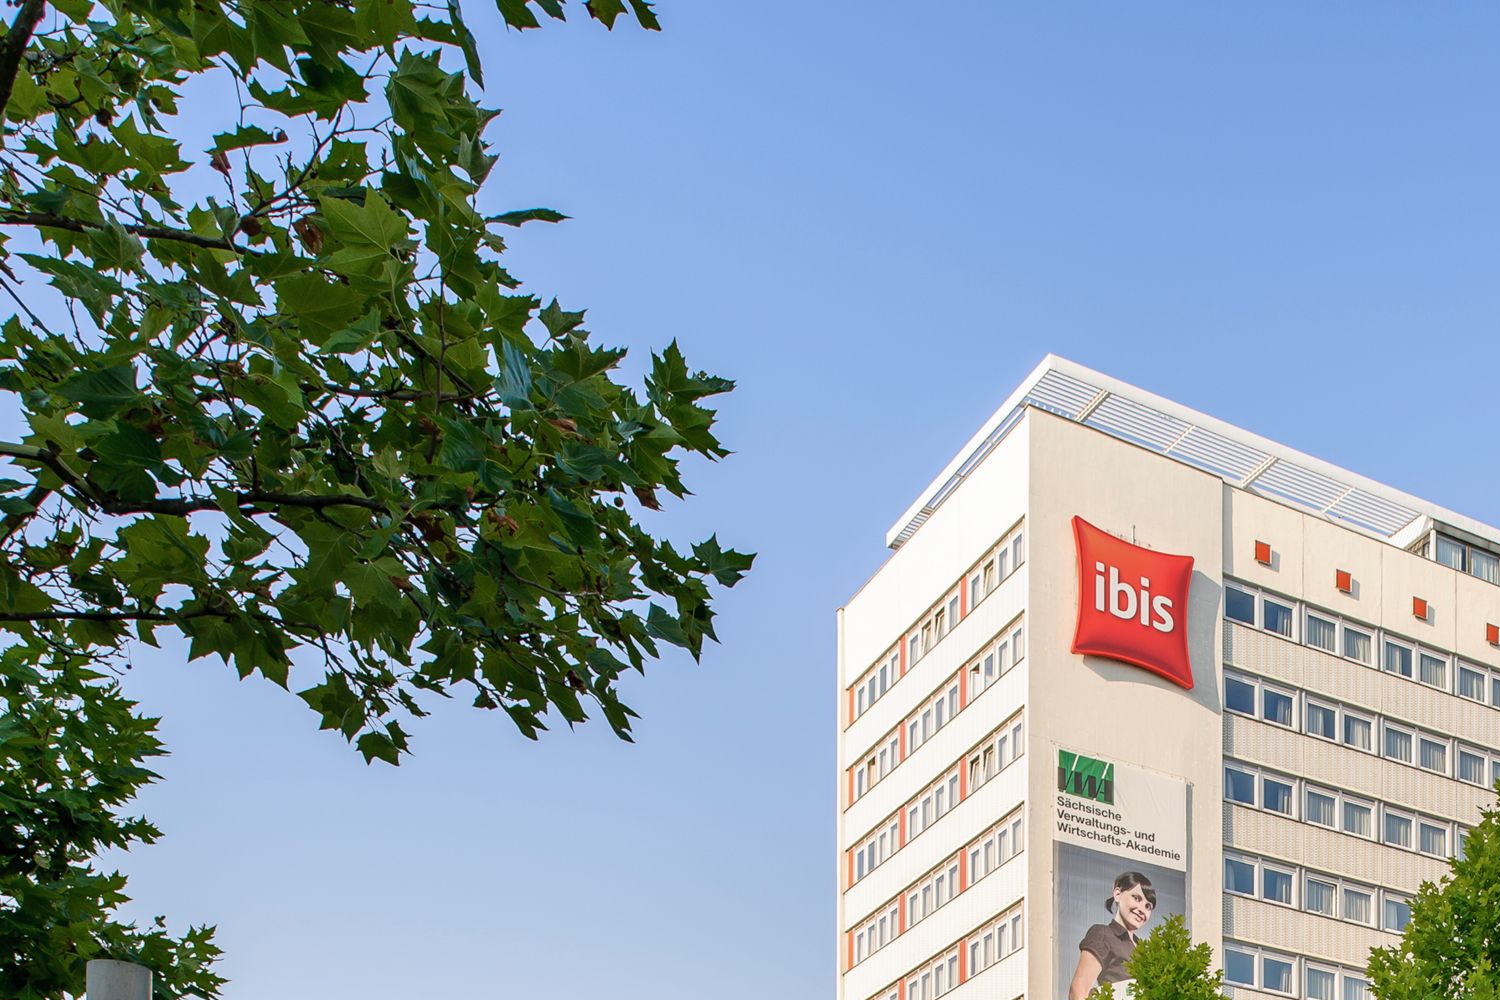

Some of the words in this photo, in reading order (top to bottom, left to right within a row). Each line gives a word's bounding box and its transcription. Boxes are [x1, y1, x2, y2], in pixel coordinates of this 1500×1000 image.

[1095, 560, 1174, 633] ibis
[1056, 796, 1122, 822] Sächsische
[1056, 808, 1131, 836] Verwaltungs-
[1134, 830, 1155, 842] und
[1056, 821, 1181, 861] Wirtschafts-Akademie
